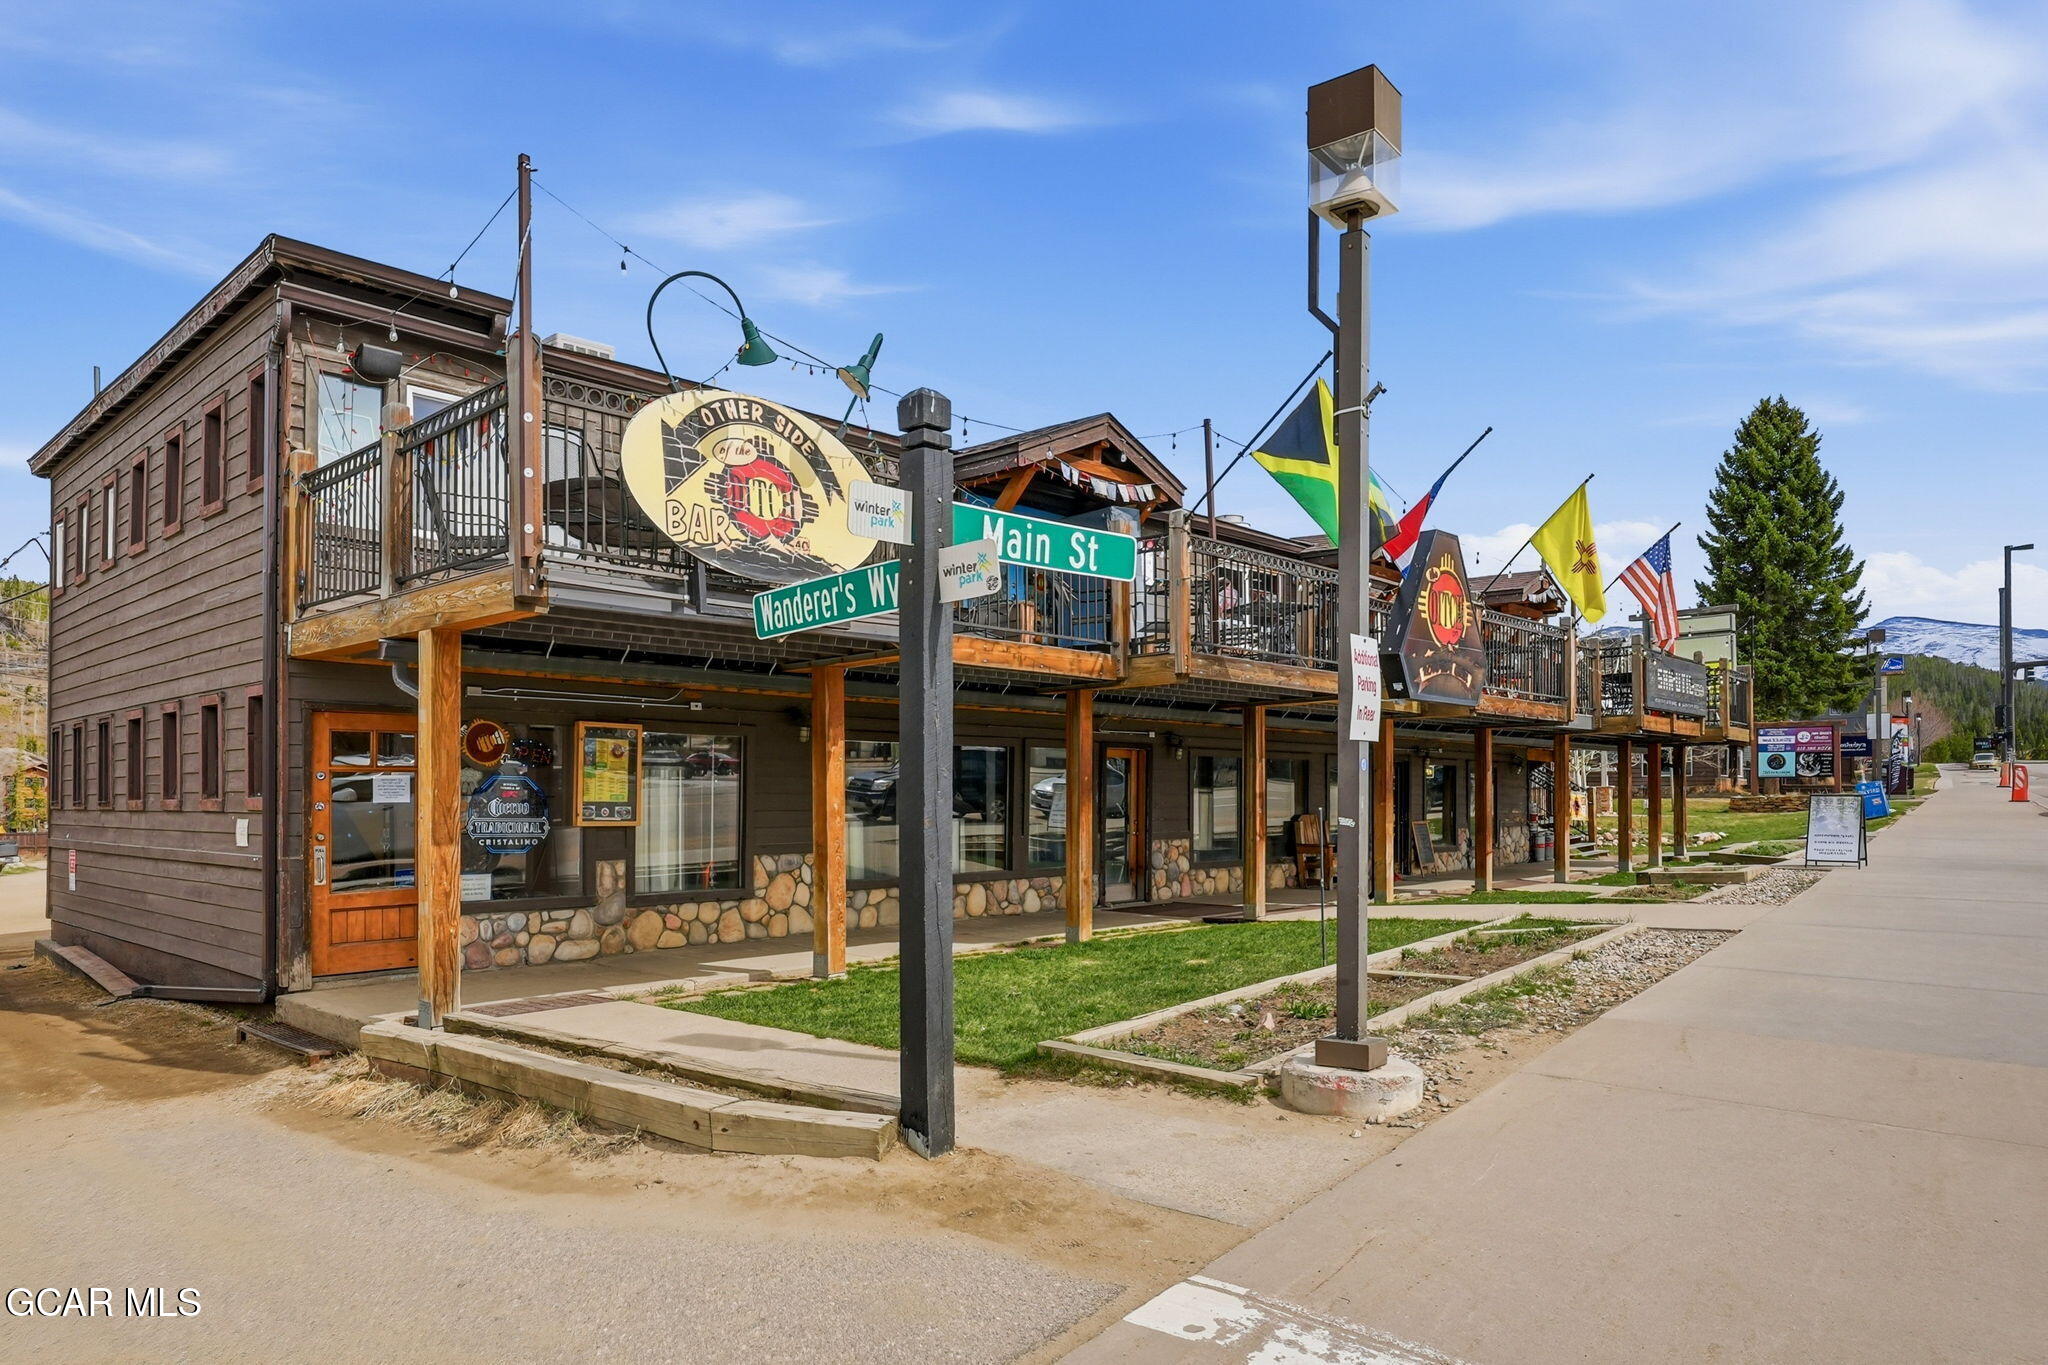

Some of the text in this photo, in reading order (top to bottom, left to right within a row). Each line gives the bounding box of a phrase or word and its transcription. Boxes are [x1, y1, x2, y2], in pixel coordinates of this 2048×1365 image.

[700, 399, 815, 457] OTHER SIDE
[735, 444, 751, 456] the
[854, 498, 892, 516] winter
[665, 499, 731, 547] BAR
[870, 515, 895, 529] park
[982, 513, 1099, 572] Main St
[942, 560, 978, 578] winter
[958, 570, 984, 588] park
[759, 565, 900, 633] Wanderer's Wy
[1354, 648, 1379, 668] Additional
[1357, 675, 1377, 697] Parking
[1356, 704, 1376, 722] In Rear
[487, 798, 530, 818] Cuervo
[474, 821, 542, 834] TRADICIONAL
[478, 838, 539, 846] CRISTALINO
